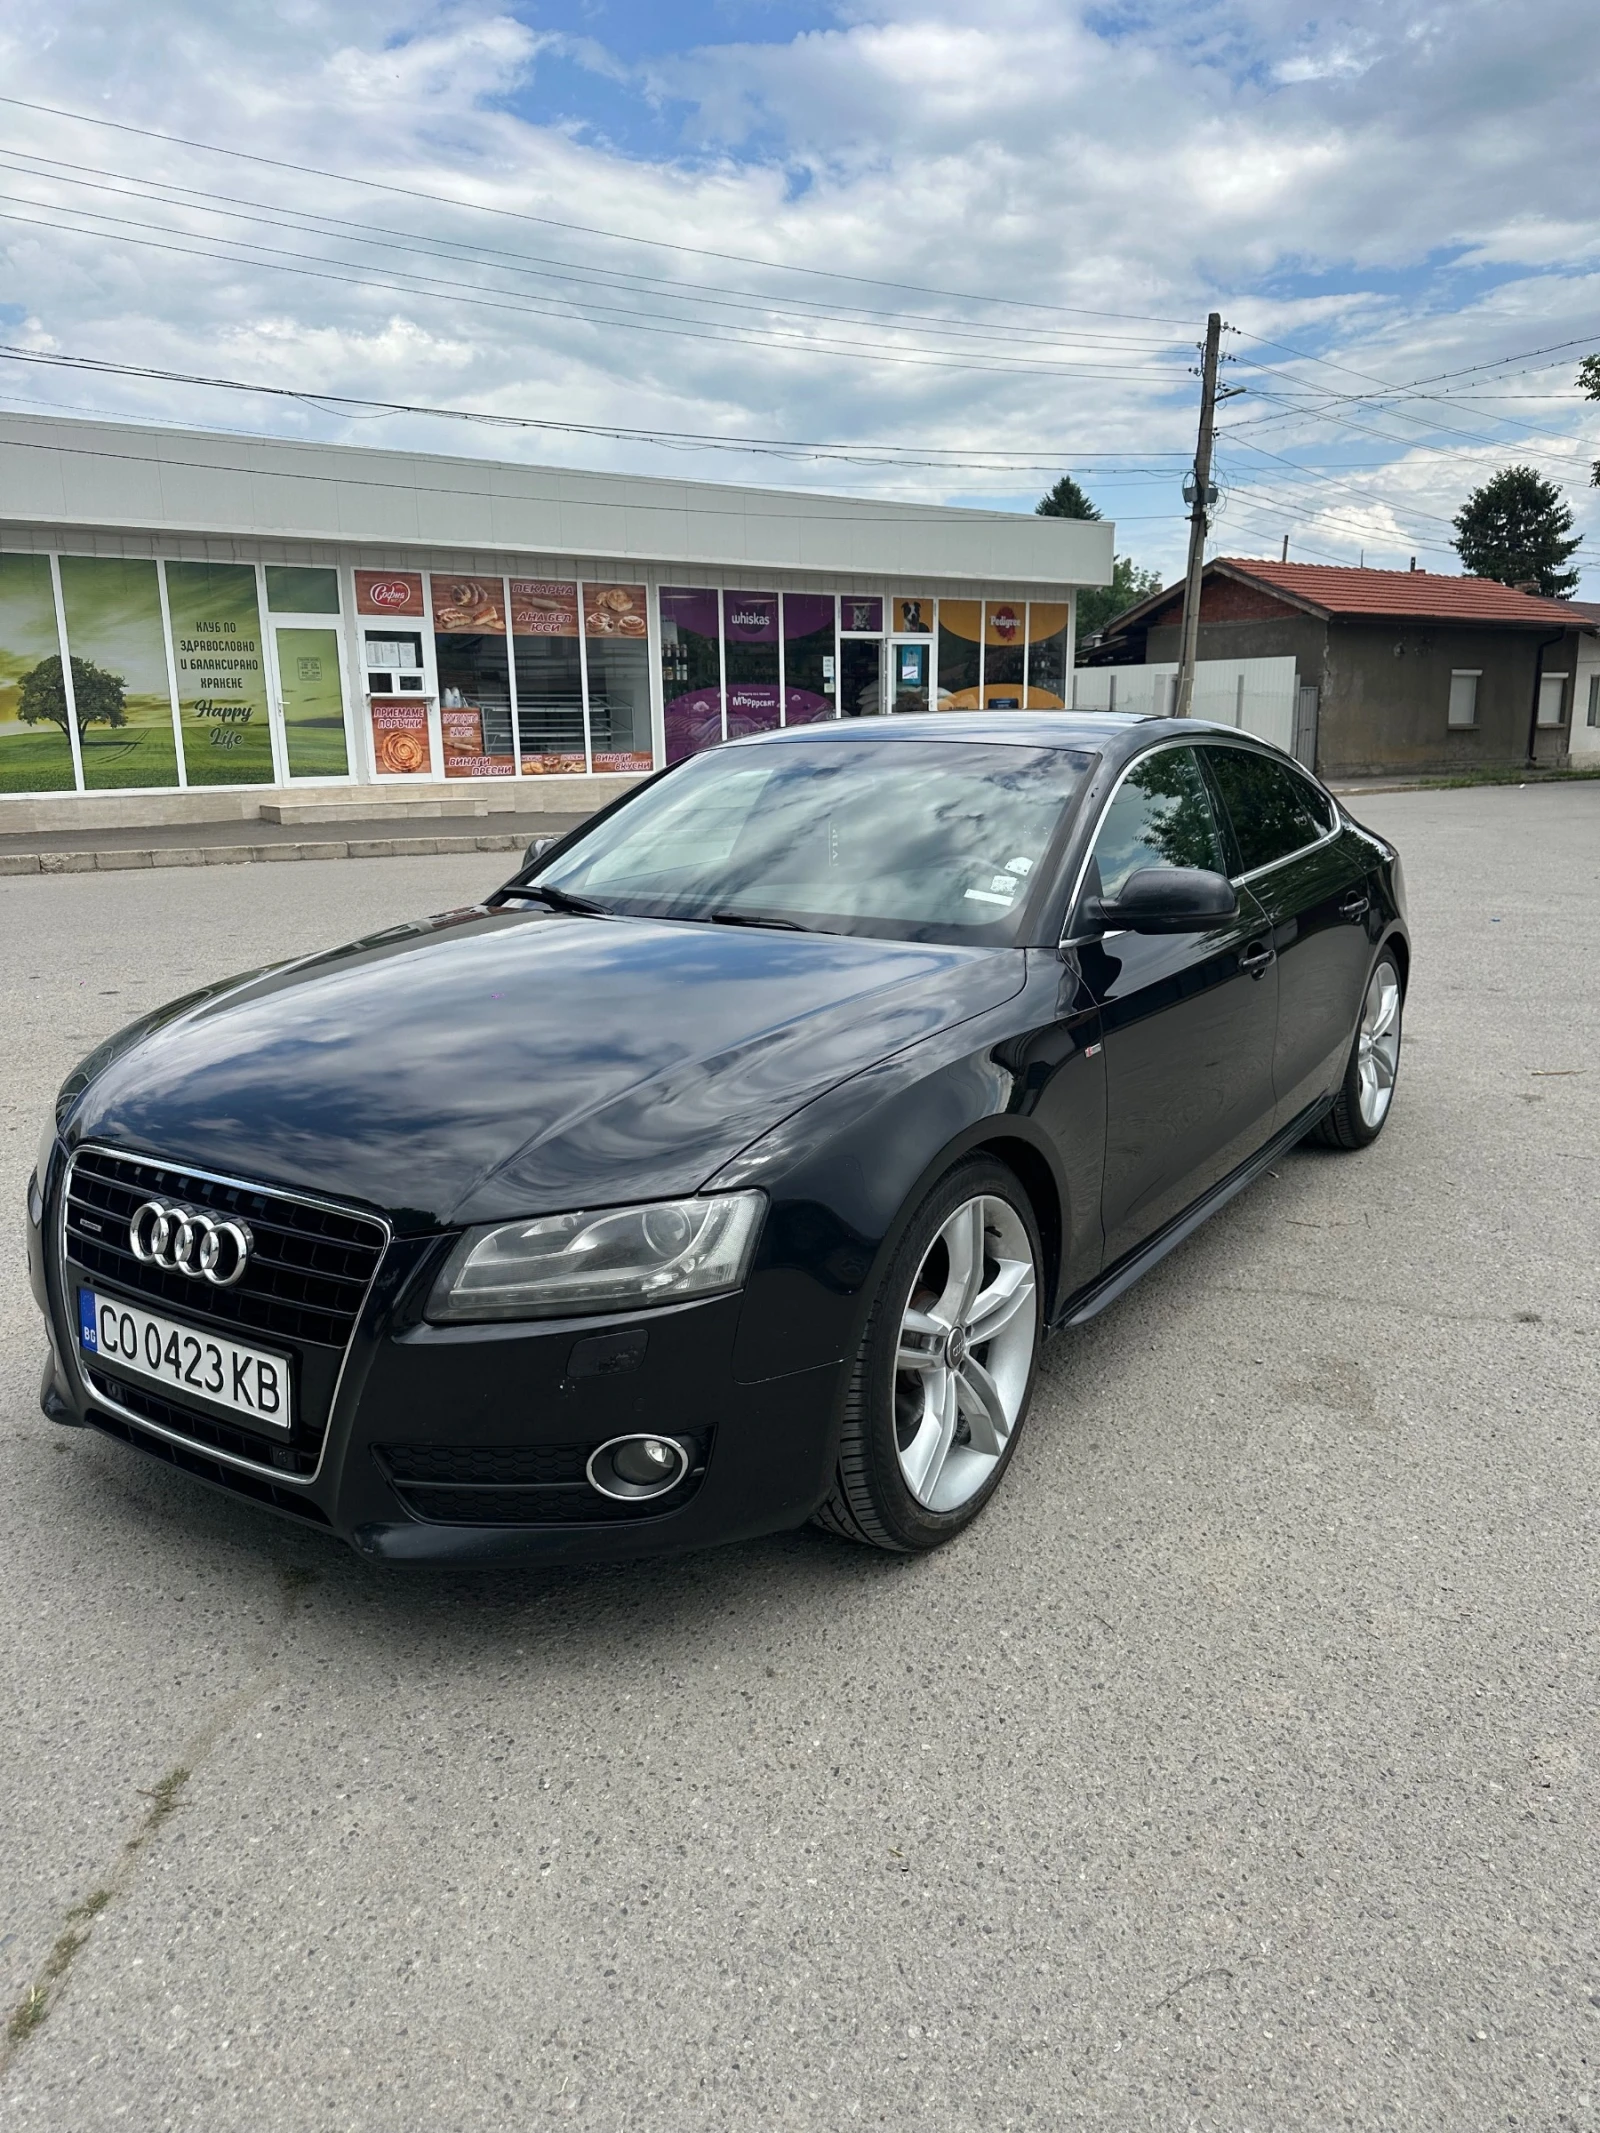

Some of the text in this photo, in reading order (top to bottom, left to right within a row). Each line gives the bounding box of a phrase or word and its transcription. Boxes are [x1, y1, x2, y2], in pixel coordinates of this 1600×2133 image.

[512, 583, 574, 595] ПЕКАРНА
[547, 612, 572, 623] БЕЛ
[731, 611, 770, 625] whiskas
[990, 615, 1021, 628] Pedigree
[196, 621, 236, 633] КЛУБ ПО
[530, 623, 561, 633] ЮСИ
[180, 640, 255, 653] ЗДРАВОСЛОВНО
[180, 659, 258, 670] И БАЛАНСИРАНО
[200, 677, 243, 689] ХРАНЕНЕ
[194, 699, 253, 723] Happy
[374, 707, 424, 718] ПРИЕМАМЕ
[378, 718, 423, 729] ПОРЪЧКИ
[210, 727, 243, 750] Life
[449, 756, 491, 767] ВИНАГИ
[595, 753, 632, 763] ВИНАГИ
[471, 765, 513, 776] ПРЕСНИ
[614, 761, 651, 770] ВКУСНИ
[84, 1326, 97, 1343] BG
[100, 1304, 281, 1414] CO 0423 KB
